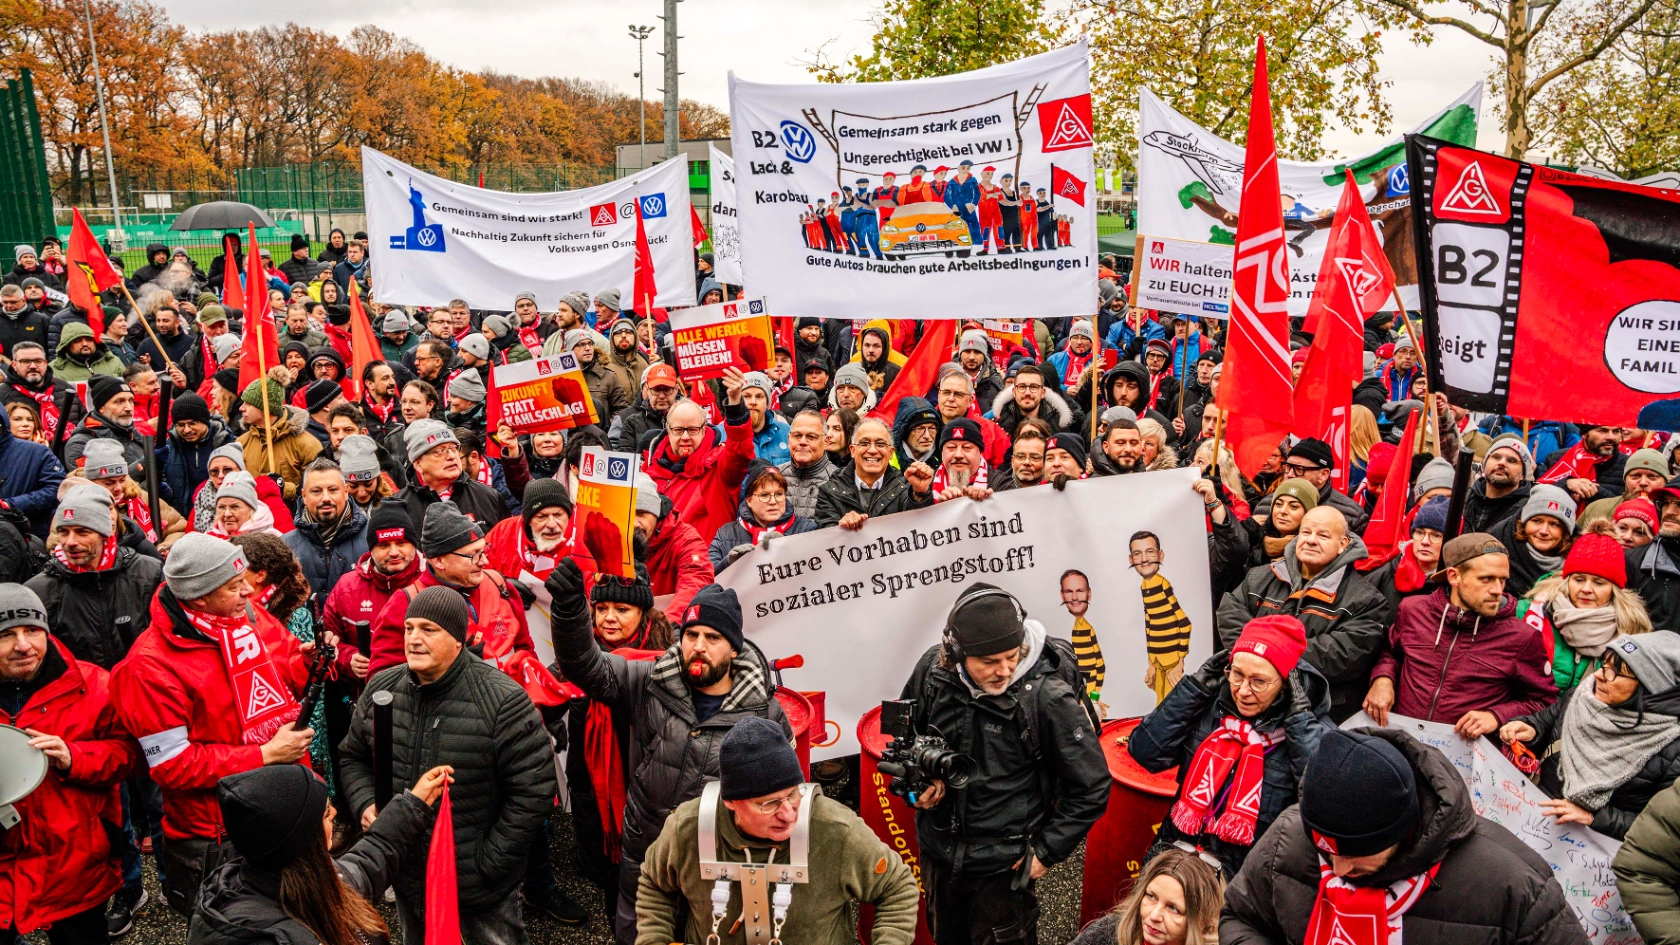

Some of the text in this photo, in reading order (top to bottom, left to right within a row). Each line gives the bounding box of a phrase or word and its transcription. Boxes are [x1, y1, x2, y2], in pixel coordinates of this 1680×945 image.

[838, 114, 1002, 139] Gemeinsam stark gegen
[751, 130, 779, 148] B2
[843, 144, 954, 166] Ungerechtigkeit
[950, 142, 973, 157] bei
[975, 140, 1003, 154] VW
[780, 160, 795, 175] &
[755, 189, 809, 204] Karobau
[432, 202, 583, 223] Gemeinsam sind wir stark!
[451, 227, 607, 243] Nachhaltig Zukunft sichern für
[548, 234, 668, 254] Volkswagen Osnaück!
[806, 255, 832, 267] Gute
[833, 257, 864, 271] Autos
[866, 261, 916, 274] brauchen
[919, 262, 945, 275] gute
[947, 258, 1082, 272] Arbeitsbedingungen
[1150, 257, 1232, 279] WIR halten
[1437, 245, 1499, 288] B2
[1149, 280, 1166, 291] zu
[1170, 280, 1214, 297] EUCH
[676, 321, 749, 345] ALLE WERKE
[1619, 316, 1654, 330] WIR
[677, 338, 726, 358] MÜSSEN
[1637, 339, 1680, 353] EINE
[680, 350, 733, 370] BLEIBEN!
[1620, 358, 1680, 374] FAMIL
[500, 382, 548, 403] ZUKUNFT
[502, 398, 536, 416] STATT
[505, 400, 586, 427] KAHLSCHLAG!
[576, 485, 601, 508] RKE
[756, 512, 1025, 585] Eure Vorhaben sind
[755, 545, 1036, 618] sozialer Sprengstoff!
[872, 771, 926, 896] Standorts
